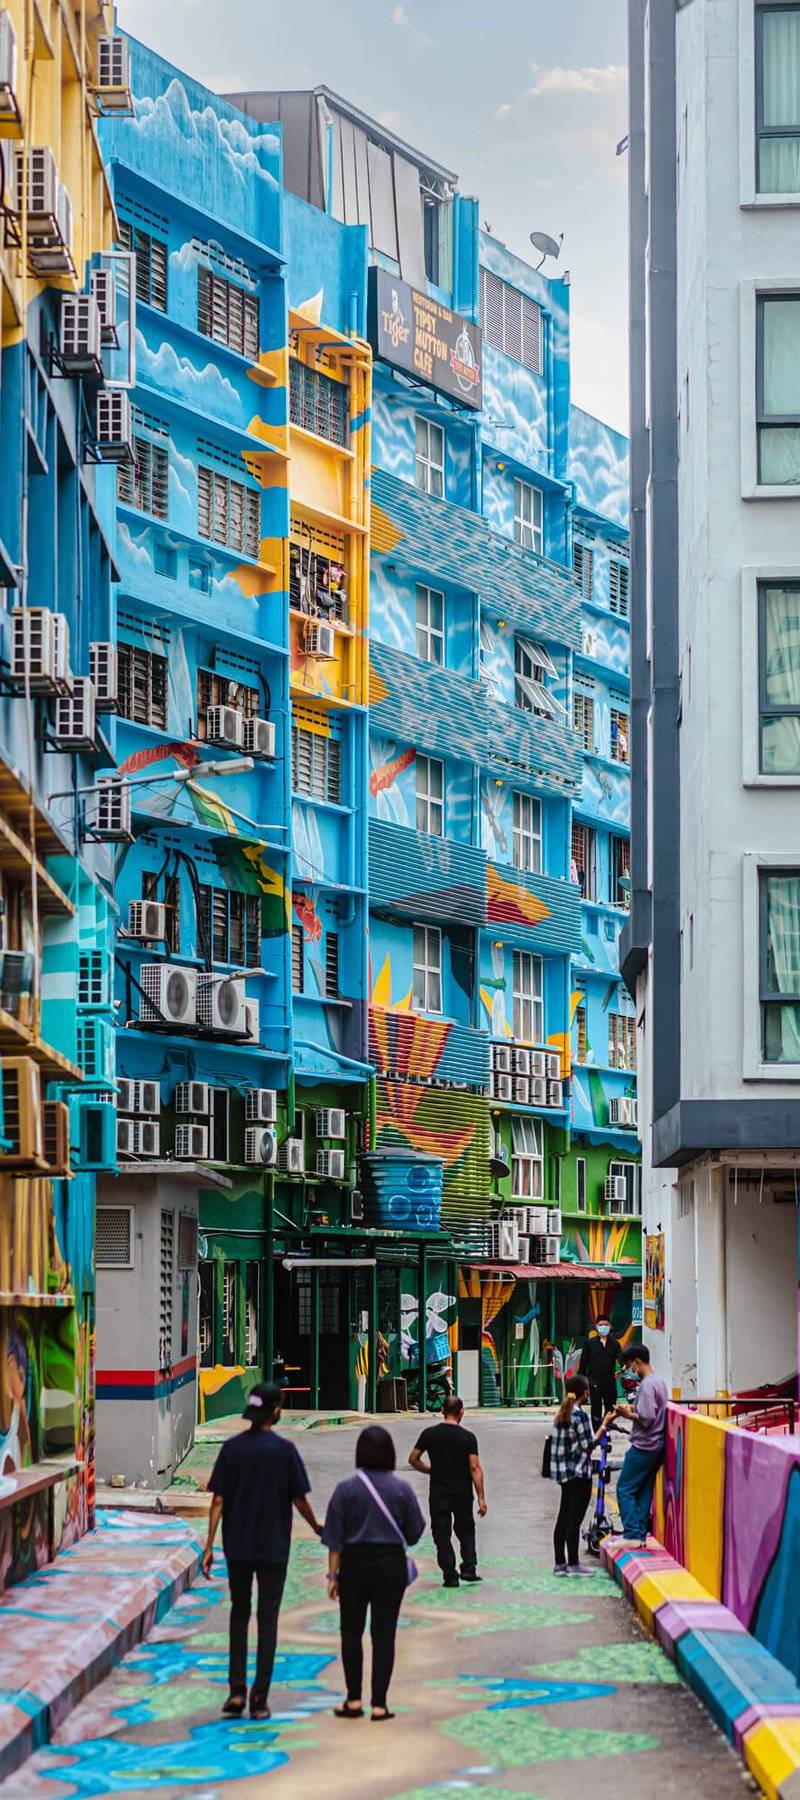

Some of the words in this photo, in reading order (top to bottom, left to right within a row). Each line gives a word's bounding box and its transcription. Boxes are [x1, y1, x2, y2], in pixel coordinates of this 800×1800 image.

[382, 310, 410, 348] Tiger
[414, 306, 436, 334] TIPSY
[415, 327, 447, 360] MUTTON
